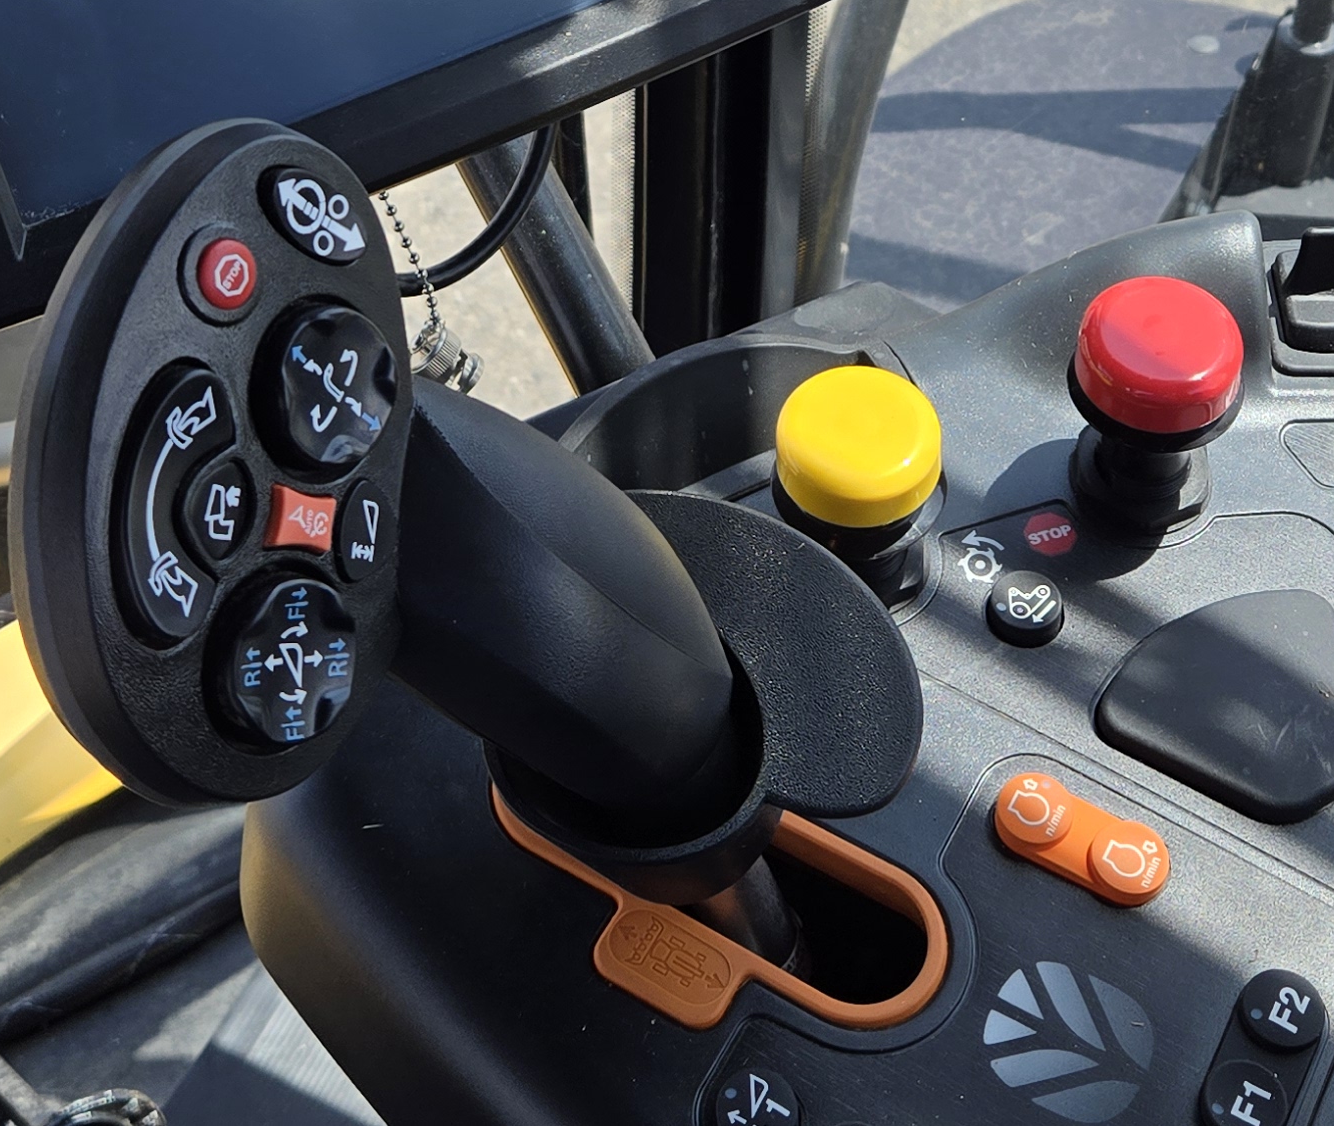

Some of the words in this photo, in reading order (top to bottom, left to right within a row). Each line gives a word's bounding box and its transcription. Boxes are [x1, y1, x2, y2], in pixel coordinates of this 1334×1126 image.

[222, 260, 242, 289] STOP
[1028, 525, 1071, 545] STOP
[1045, 805, 1066, 837] n/min
[1141, 856, 1162, 888] n/min
[1268, 986, 1311, 1034] F2
[1230, 1080, 1272, 1126] F1
